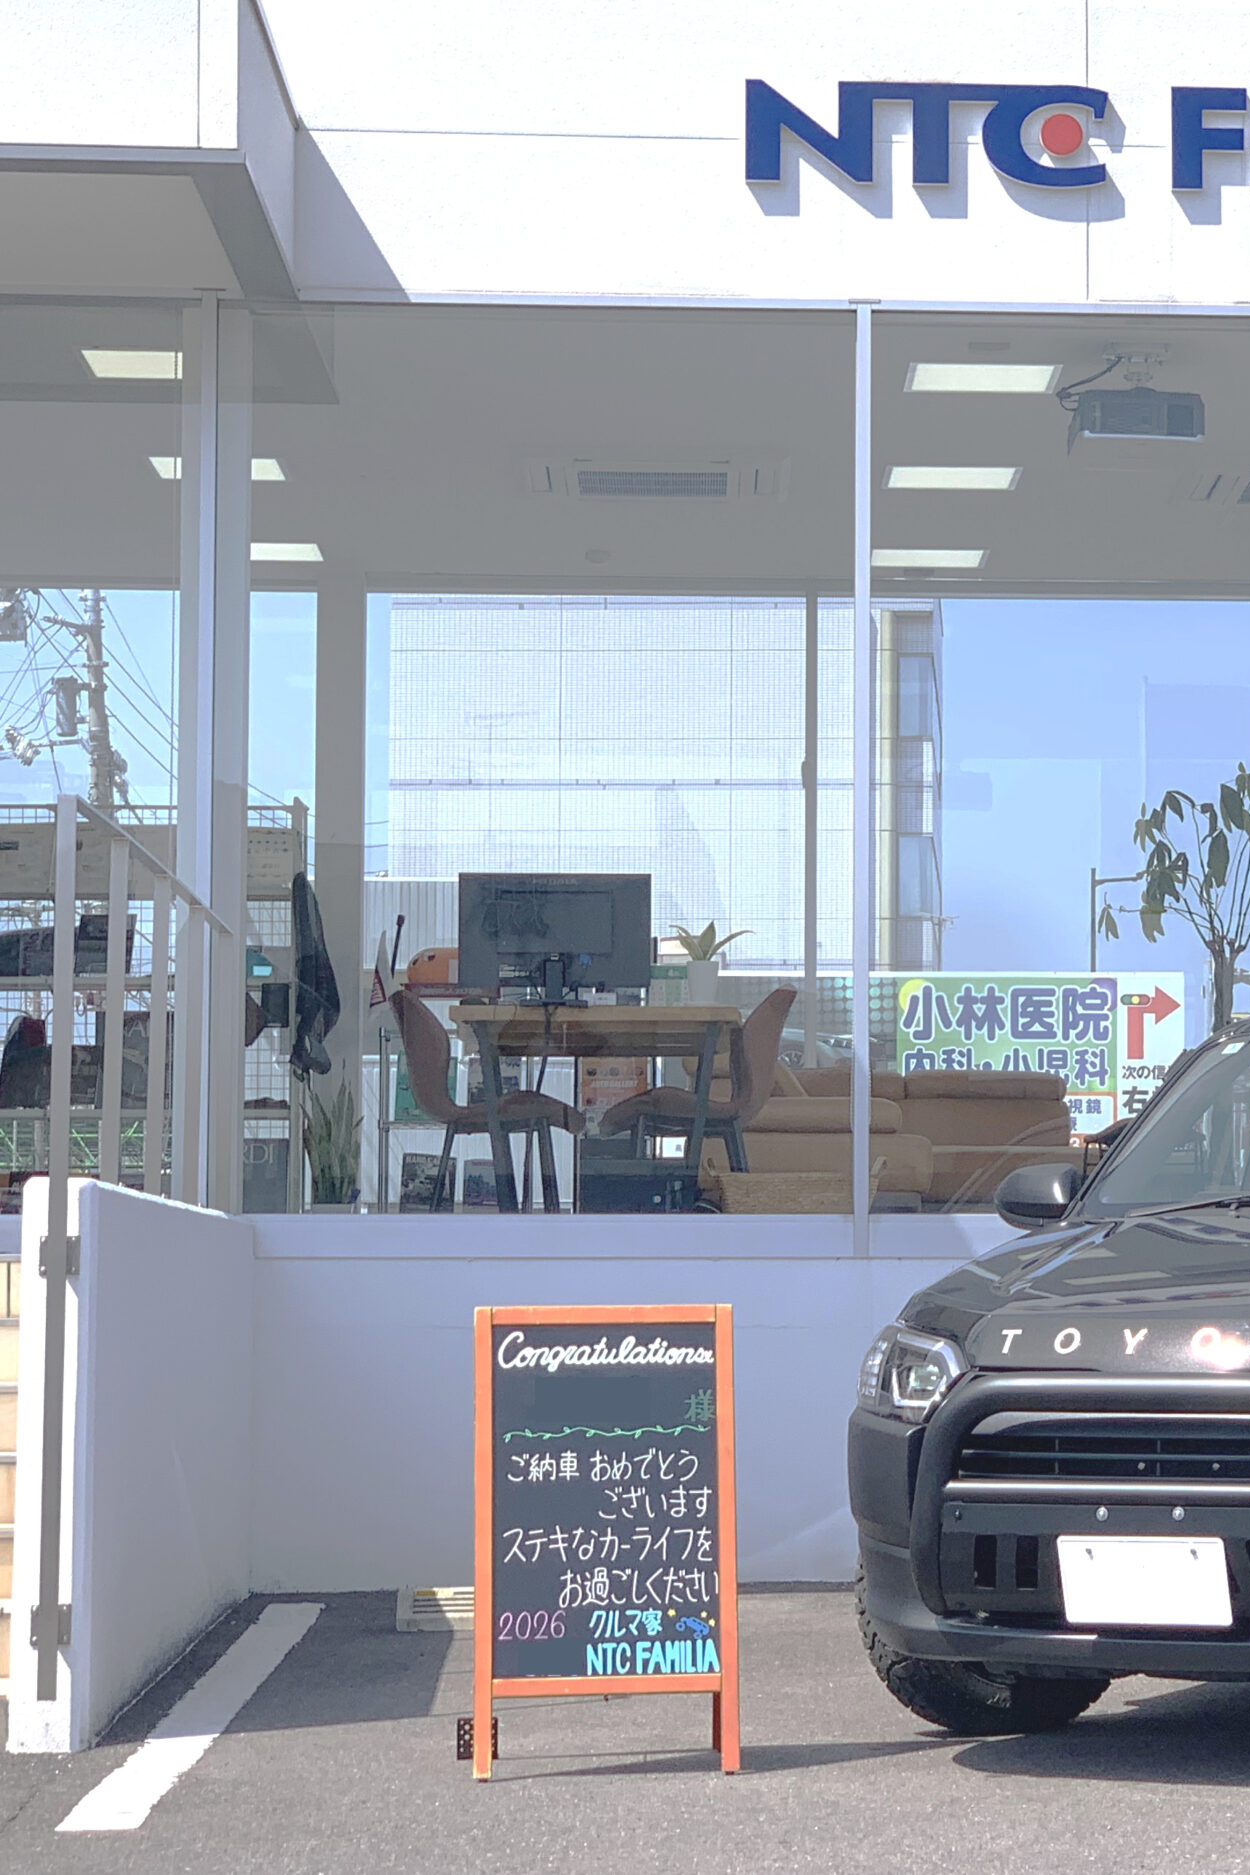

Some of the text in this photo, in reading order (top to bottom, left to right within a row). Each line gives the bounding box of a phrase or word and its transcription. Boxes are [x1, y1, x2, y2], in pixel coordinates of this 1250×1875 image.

[745, 78, 1109, 189] NTC
[901, 983, 1111, 1042] 小林医院
[1121, 1064, 1171, 1080] 次の信
[1121, 1085, 1162, 1115] 右
[683, 1388, 716, 1422] 様
[507, 1447, 699, 1482] ご納車 おめでとう
[598, 1484, 713, 1519] ございます
[502, 1525, 714, 1563] ステキなカーライフを
[558, 1566, 719, 1608] お過ごしください
[498, 1610, 567, 1640] 2026
[588, 1608, 663, 1639] クルマ家
[586, 1638, 721, 1676] NTC FAMILIA
